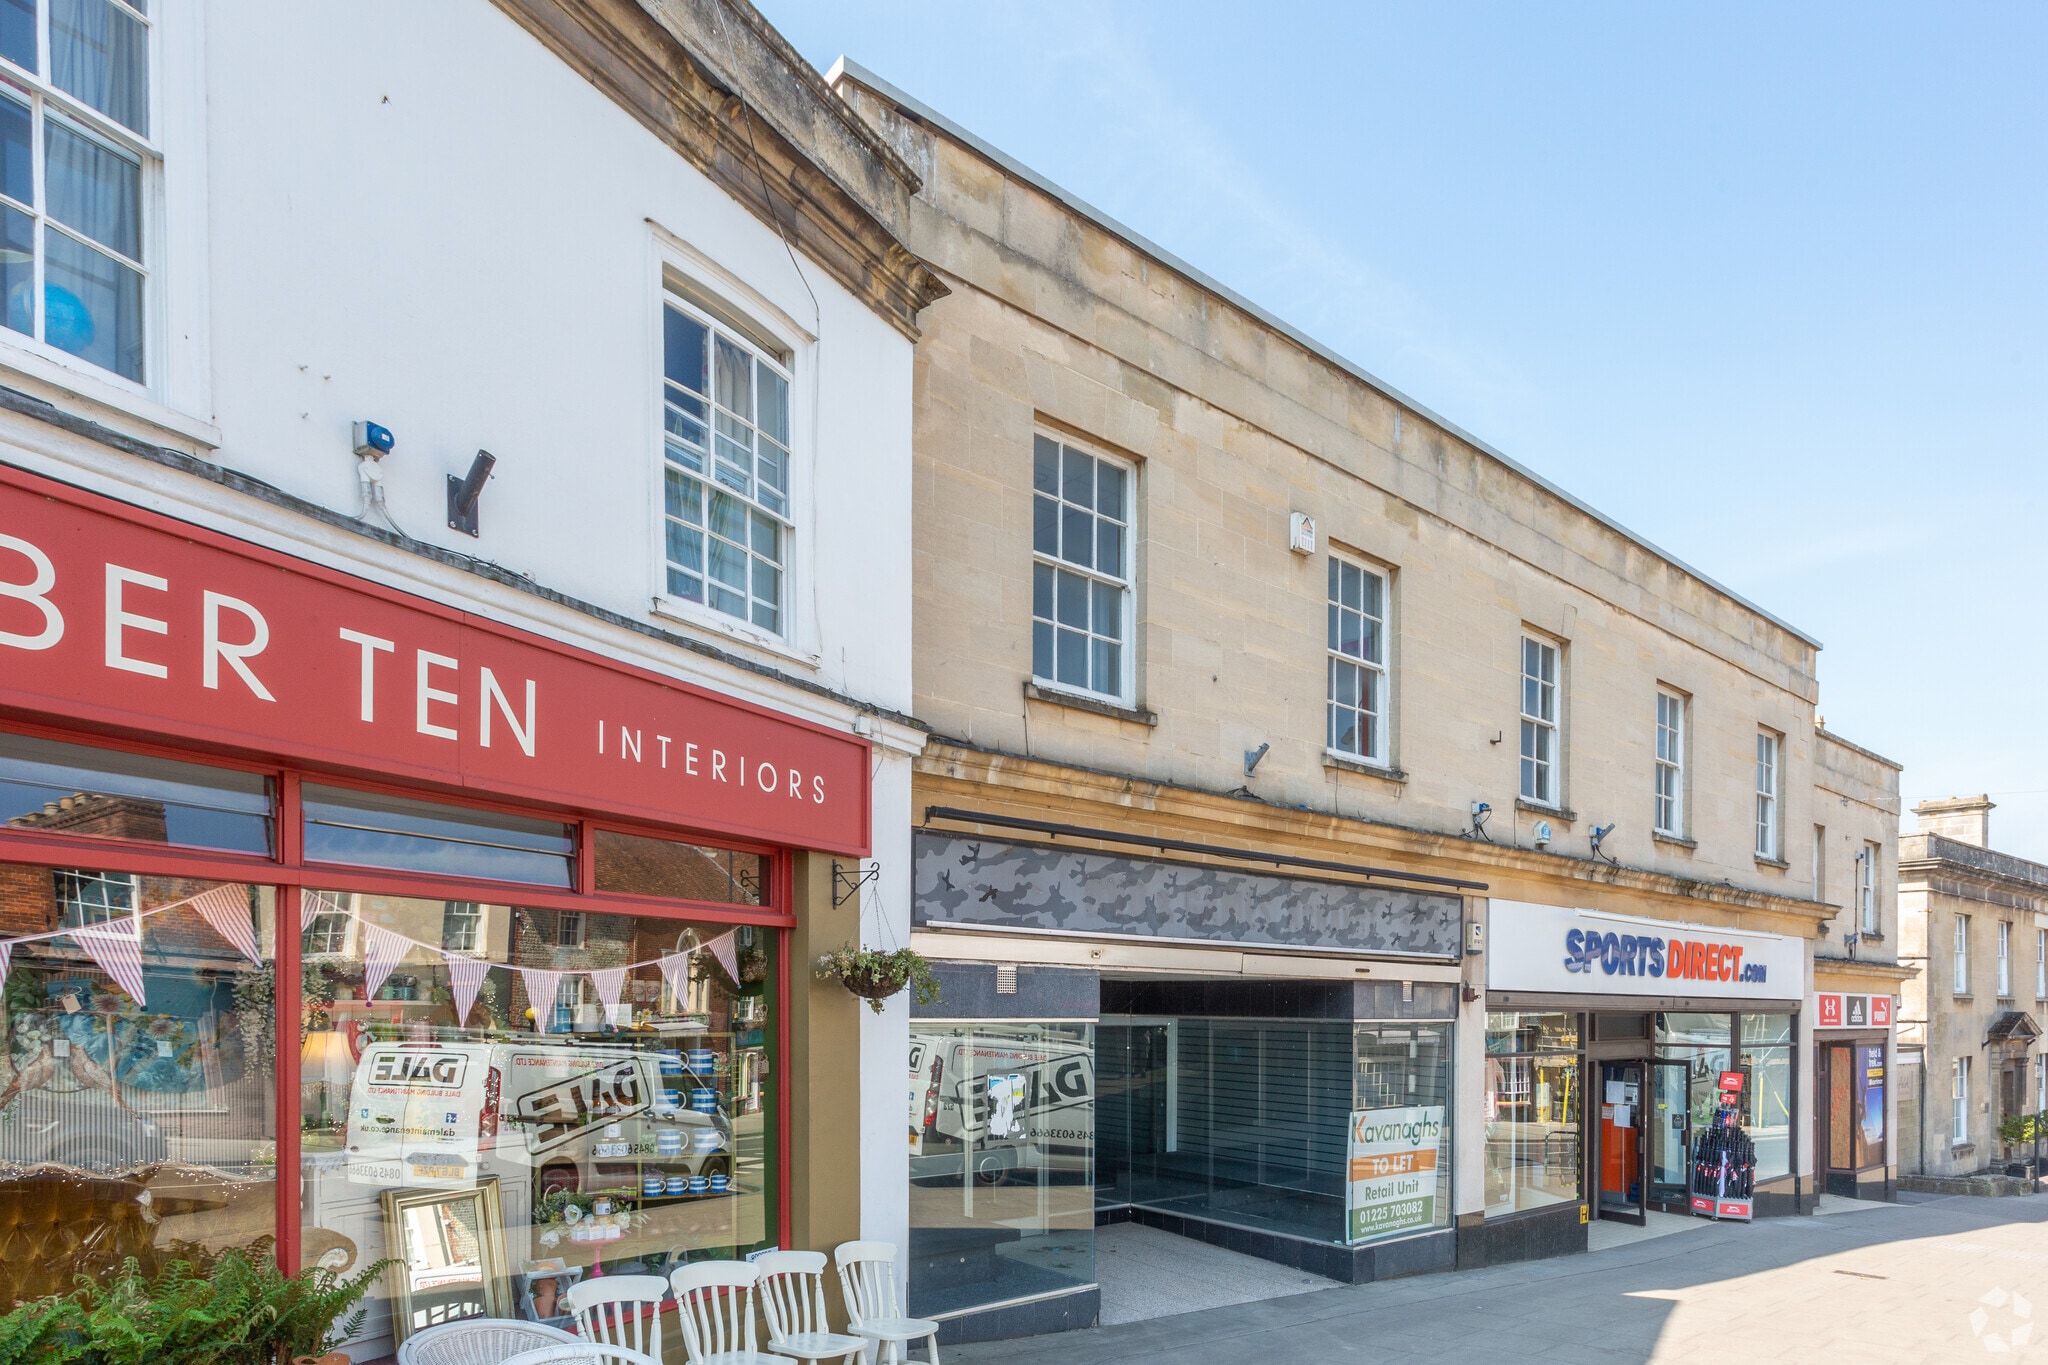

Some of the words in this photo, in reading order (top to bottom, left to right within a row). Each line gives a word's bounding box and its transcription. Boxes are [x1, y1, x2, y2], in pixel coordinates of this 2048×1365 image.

[339, 627, 536, 757] TEN
[599, 720, 825, 804] INTERIORS
[1352, 1111, 1439, 1146] Kavanaghs
[1372, 1157, 1389, 1175] TO
[1393, 1154, 1414, 1172] LET
[1365, 1182, 1394, 1201] Retail
[1397, 1179, 1419, 1196] Unit
[1360, 1207, 1388, 1224] 01225
[1390, 1201, 1423, 1218] 703082
[1360, 1214, 1422, 1234] www.kavanaghs.co.uk
